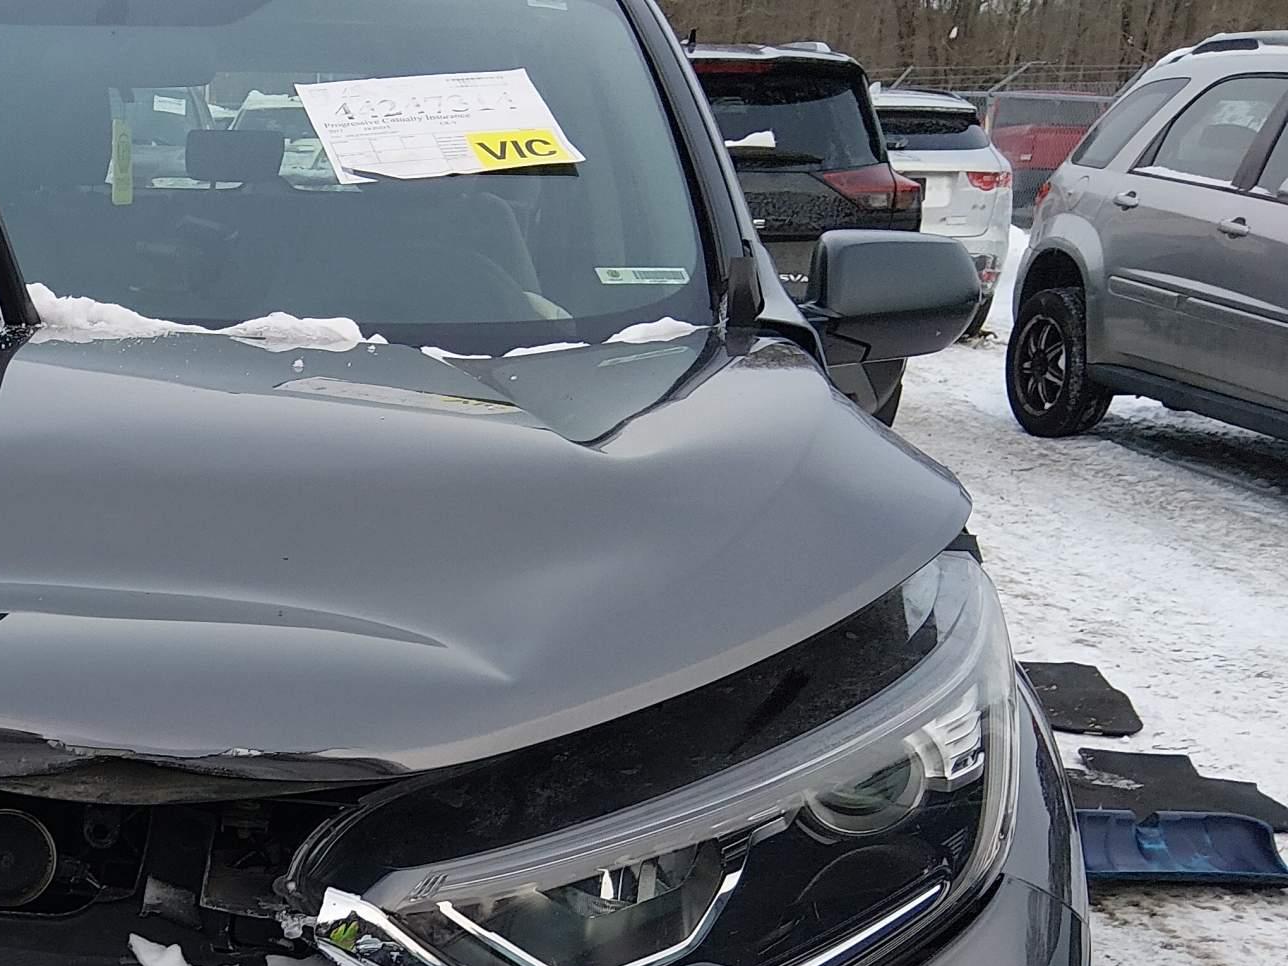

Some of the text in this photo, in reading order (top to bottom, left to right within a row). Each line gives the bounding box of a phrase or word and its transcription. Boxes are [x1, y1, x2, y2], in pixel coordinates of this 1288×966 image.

[324, 117, 380, 129] Progressive
[381, 113, 423, 124] Casualty
[425, 112, 470, 121] Insurance
[474, 138, 558, 161] VIC
